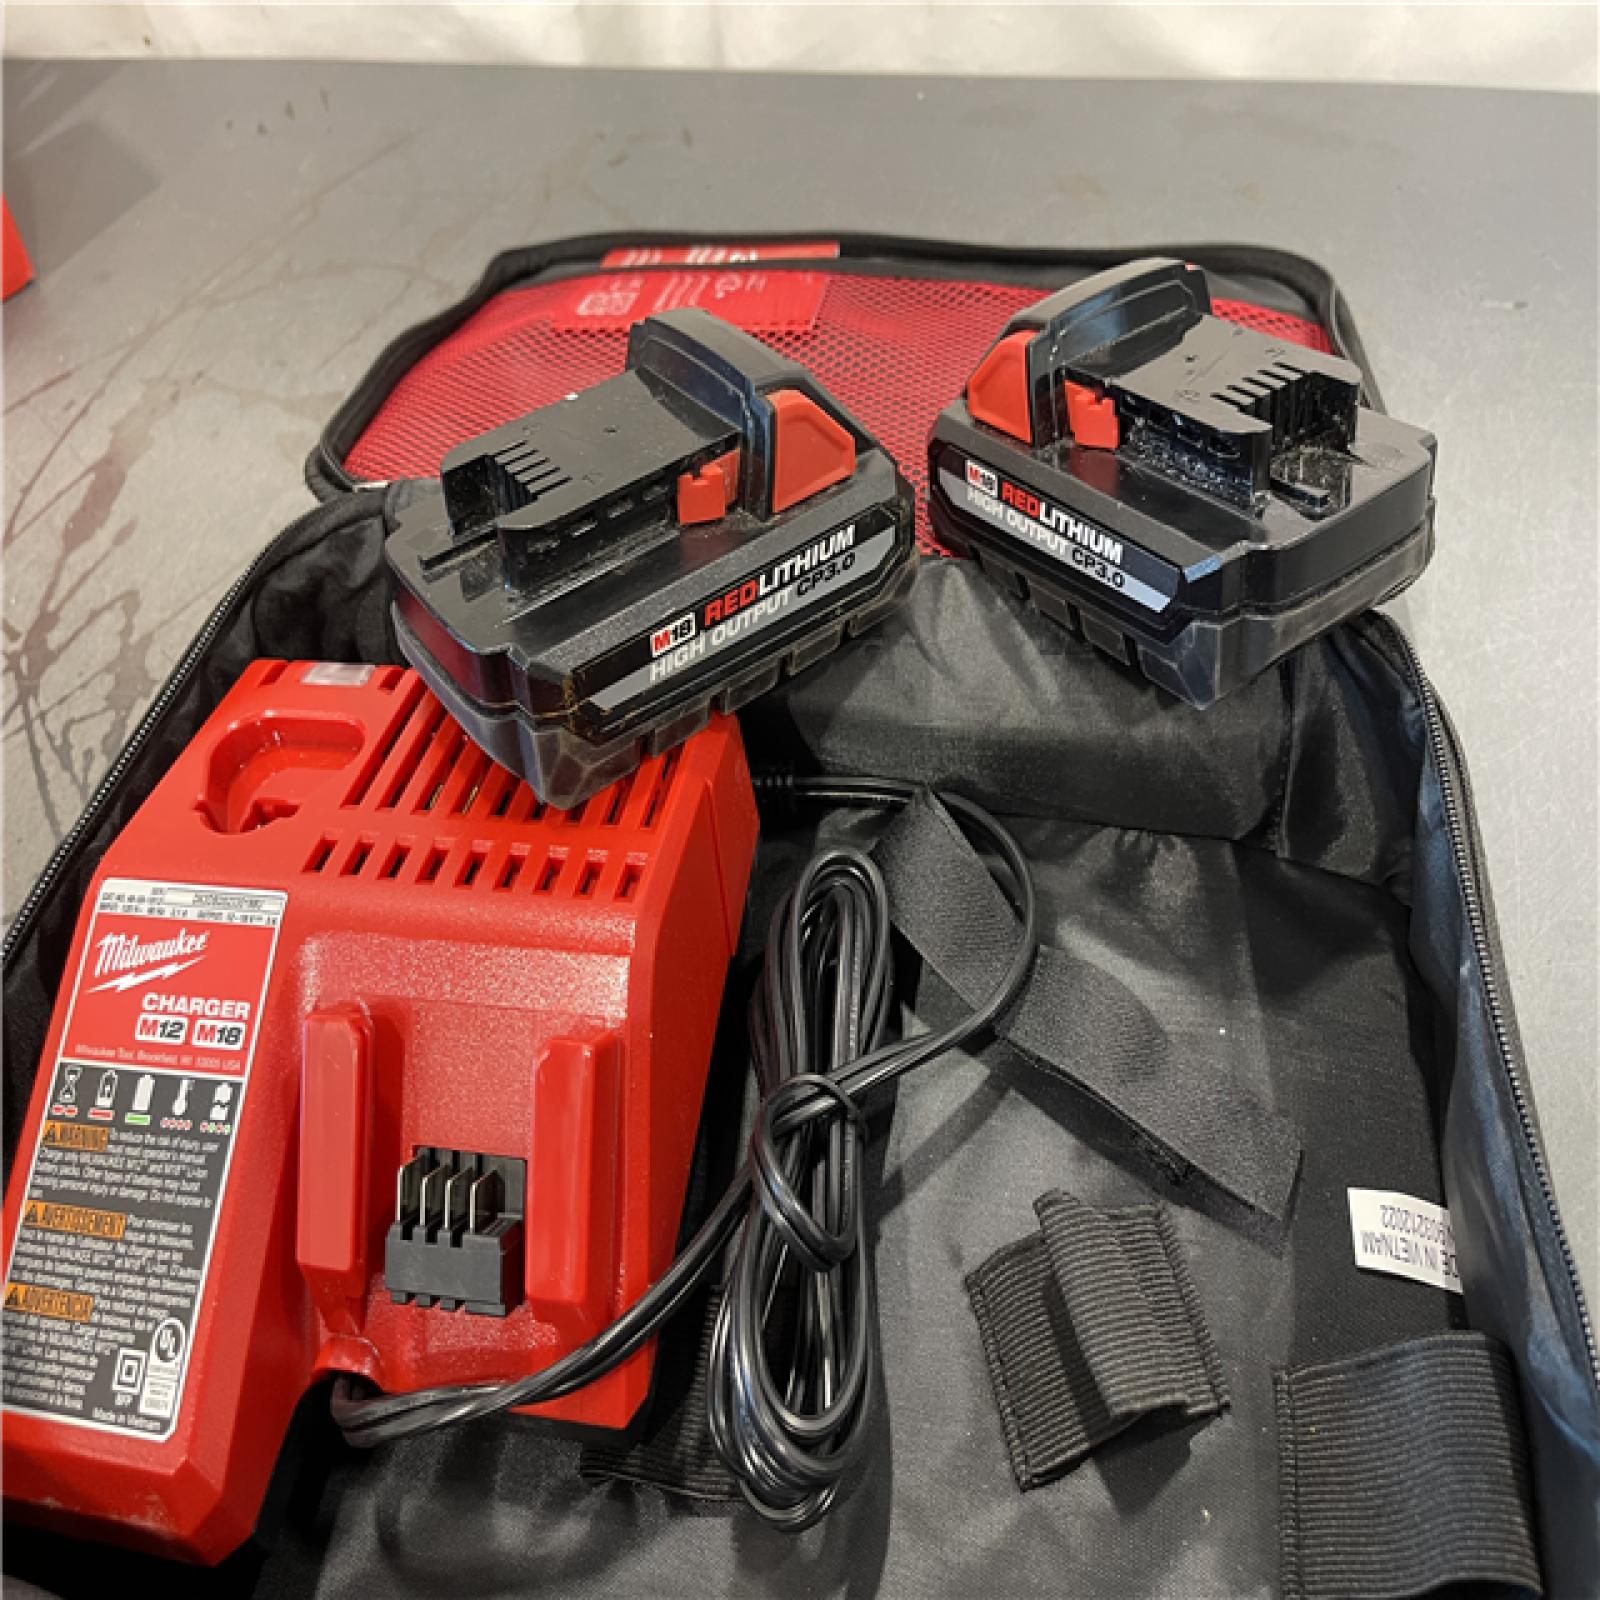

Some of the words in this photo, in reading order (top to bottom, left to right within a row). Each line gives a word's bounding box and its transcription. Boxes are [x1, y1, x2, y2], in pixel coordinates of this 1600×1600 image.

[967, 487, 1003, 518] HIGH
[1007, 508, 1070, 555] OUTPUT
[1072, 547, 1124, 588] CP3.0
[1001, 480, 1123, 564] REDLITHIUM
[650, 629, 706, 681] HIGH
[712, 585, 793, 646] OUTPUT
[797, 552, 856, 597] CP3.0
[651, 613, 695, 656] M18
[705, 525, 856, 628] REDLITHIUM
[93, 928, 208, 978] Milwaukee
[138, 1016, 187, 1042] M12
[196, 1022, 244, 1047] M18
[141, 992, 250, 1020] CHARGER
[1360, 1230, 1424, 1267] VIETNAM
